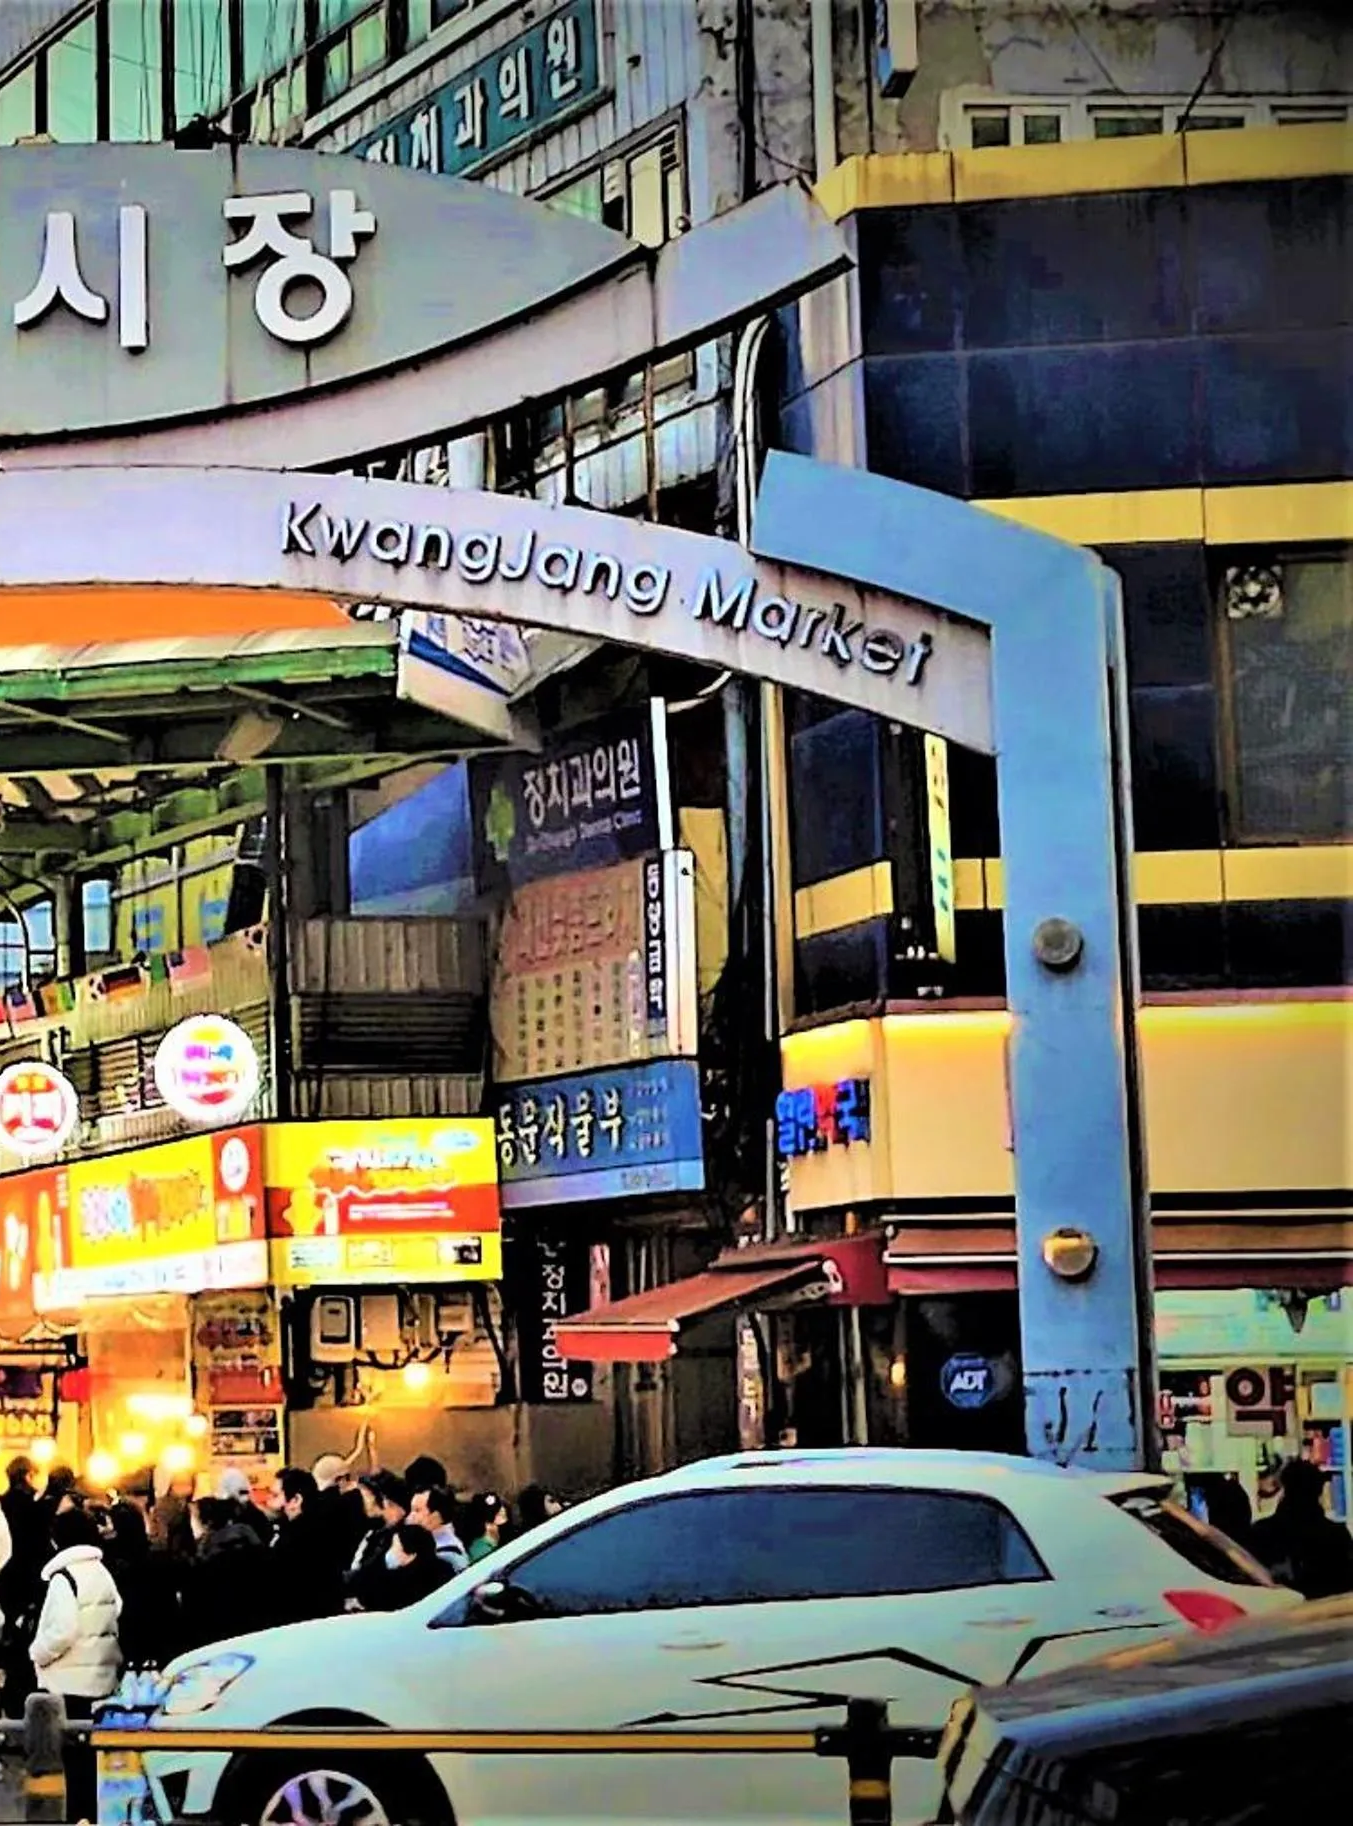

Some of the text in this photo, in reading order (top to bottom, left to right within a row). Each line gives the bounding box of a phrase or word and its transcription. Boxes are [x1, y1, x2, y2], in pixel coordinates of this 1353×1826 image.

[366, 16, 578, 174] 치과의원
[281, 501, 934, 686] KwangJang Market
[523, 738, 642, 828] 정치과의원
[950, 1369, 987, 1393] ADT
